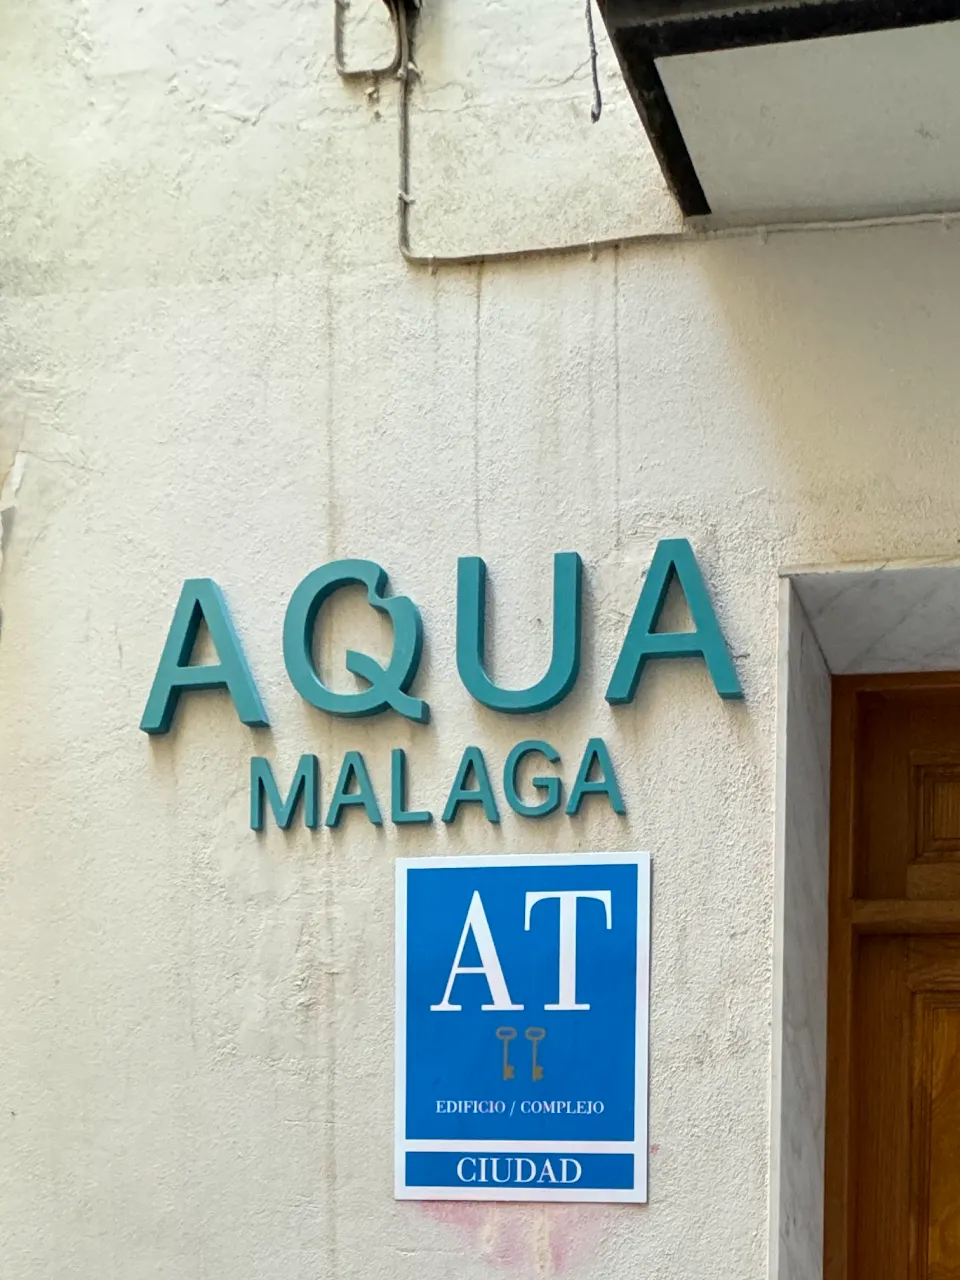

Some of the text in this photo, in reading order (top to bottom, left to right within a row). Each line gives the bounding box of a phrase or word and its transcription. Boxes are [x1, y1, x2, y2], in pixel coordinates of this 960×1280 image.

[139, 538, 744, 734] AQUA
[250, 738, 626, 831] MALAGA
[430, 889, 613, 1012] AT
[435, 1100, 506, 1114] EDIFICIO
[520, 1100, 605, 1115] COMPLEJO
[456, 1157, 582, 1184] CIUDAD
